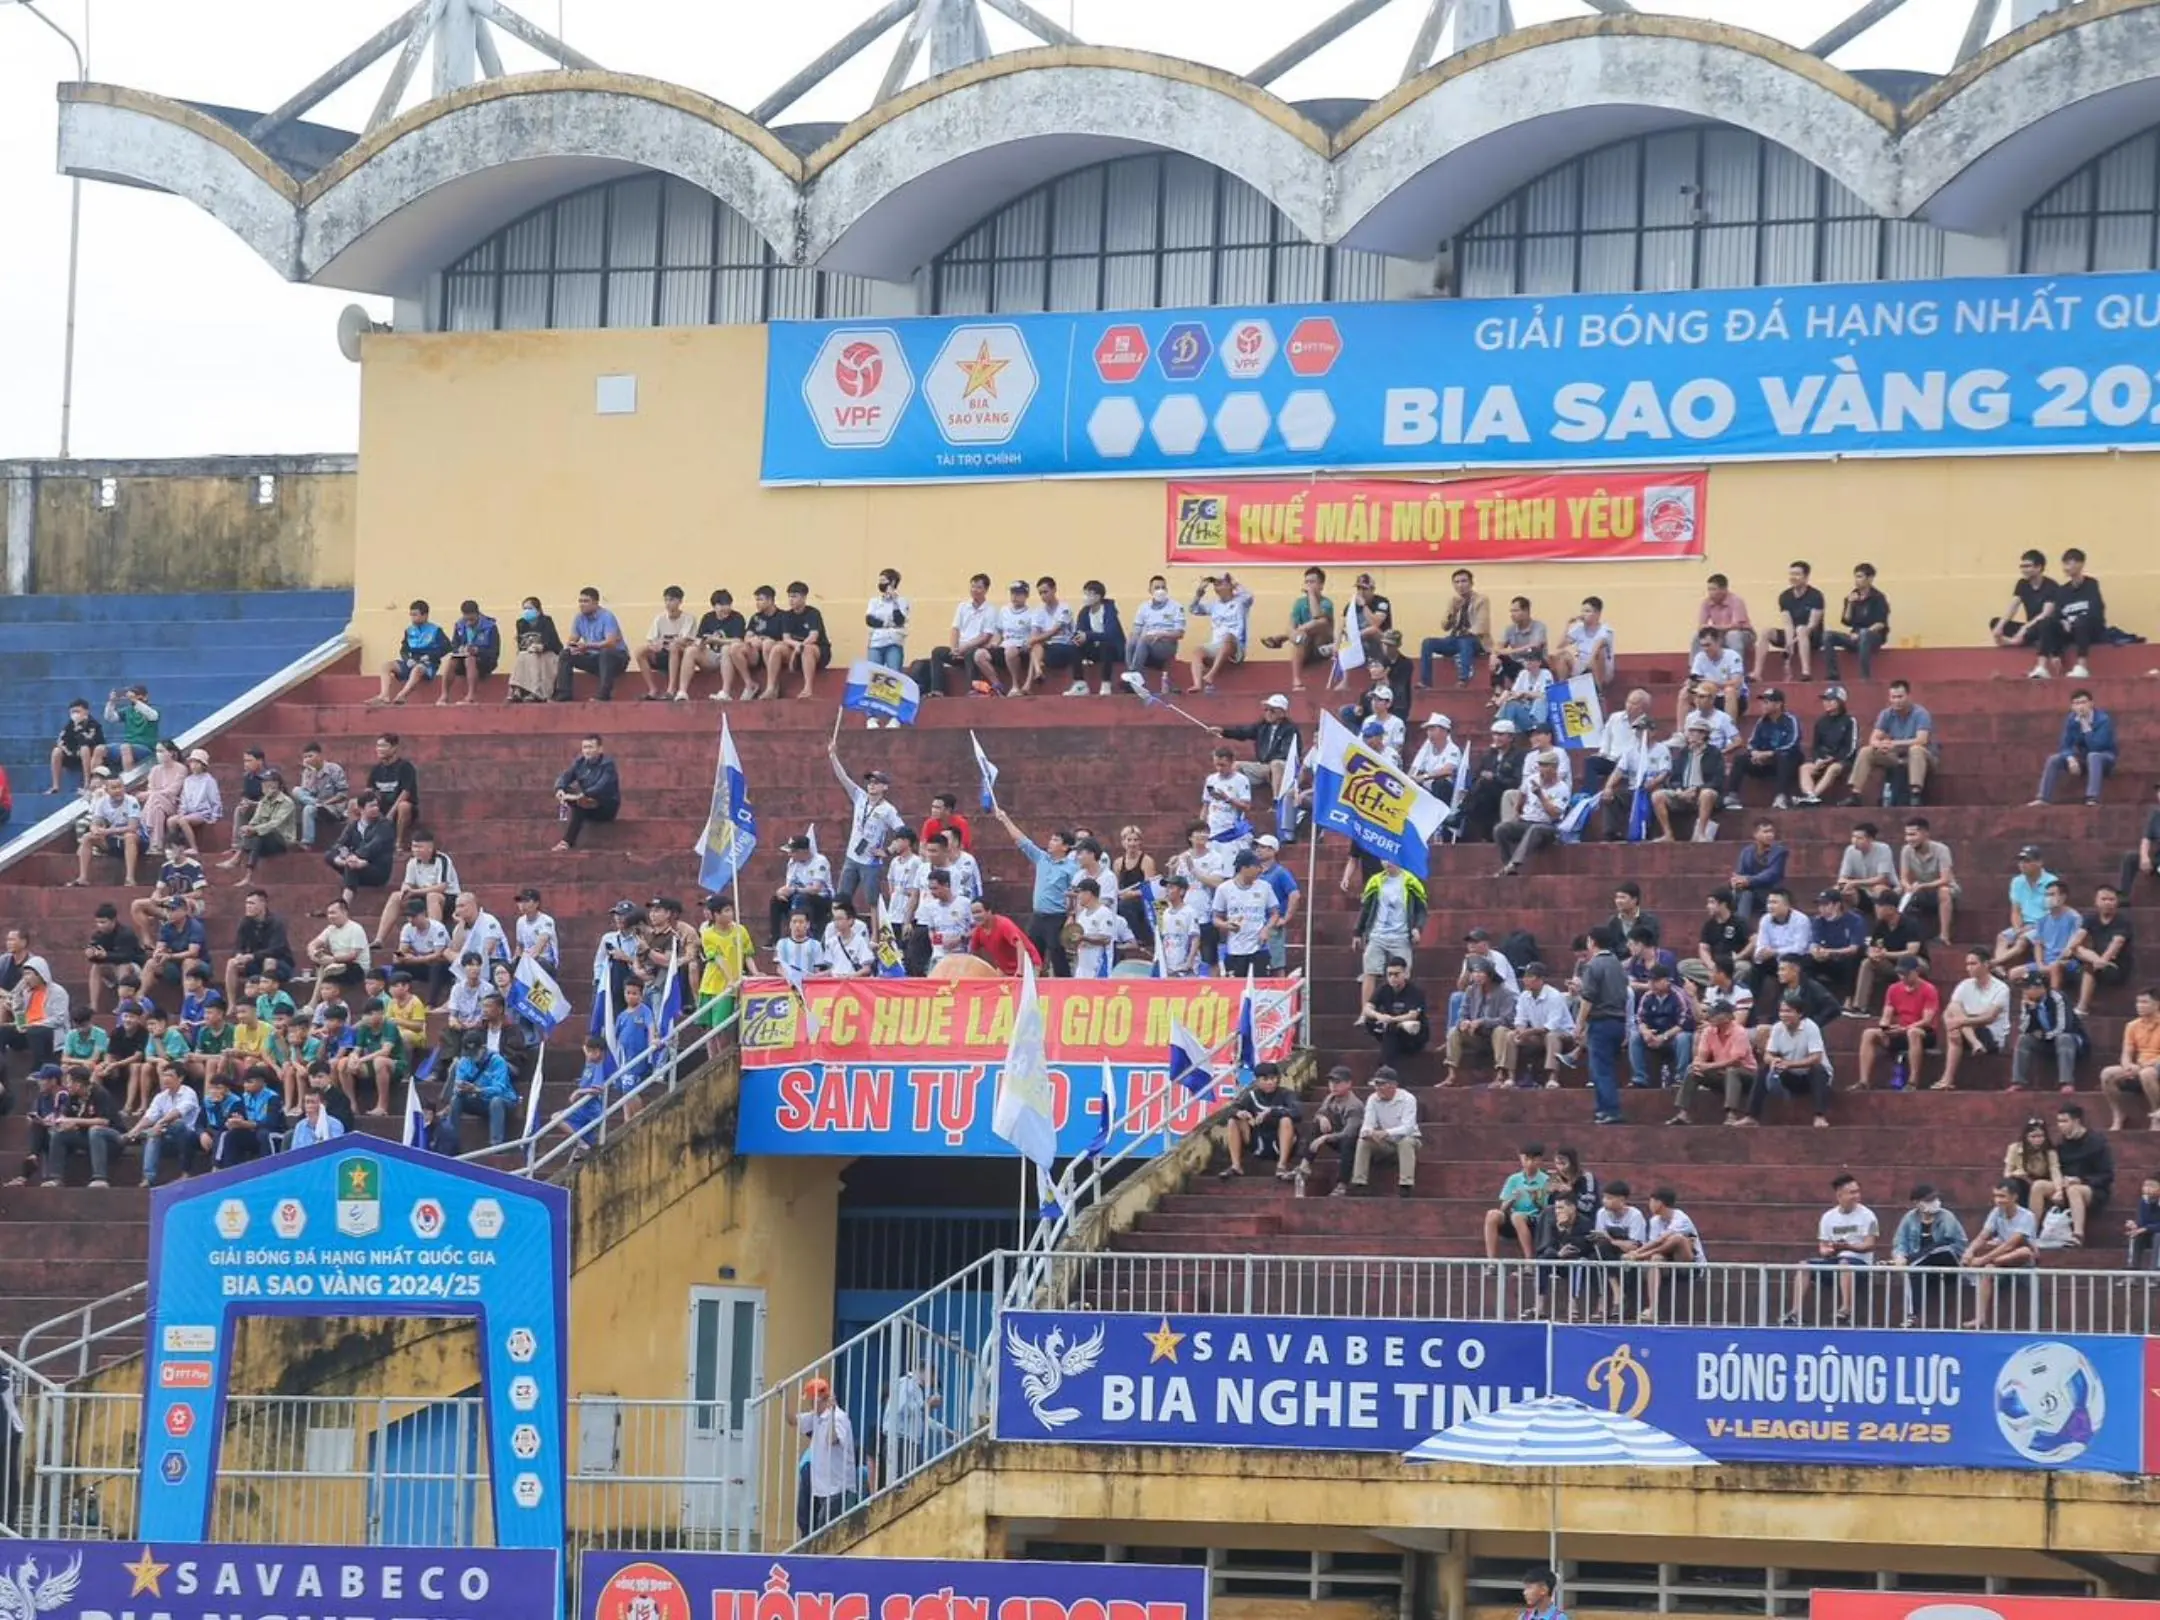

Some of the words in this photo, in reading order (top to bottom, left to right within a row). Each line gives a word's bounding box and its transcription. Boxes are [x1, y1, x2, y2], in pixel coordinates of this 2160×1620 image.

[1475, 304, 1564, 350] GIẢI
[1579, 305, 1708, 347] BÓNG
[1725, 298, 1789, 342] ĐÁ
[1806, 301, 1939, 346] HẠNG
[1955, 282, 2081, 333] NHẤT
[834, 406, 881, 427] VPF
[949, 413, 972, 425] SAO
[969, 399, 989, 409] BIA
[1383, 385, 1531, 446] BIA
[1549, 378, 1736, 442] SAO
[1759, 354, 2012, 436] VÀNG
[2032, 364, 2160, 428] 20
[936, 453, 954, 466] TÀI
[984, 451, 1021, 465] CHÍNH
[1239, 490, 1310, 544] HUẾ
[1315, 494, 1381, 543] MÃI
[1391, 492, 1464, 551] MỘT
[1475, 490, 1556, 541] TÌNH
[1567, 488, 1635, 540] YÊU
[744, 996, 789, 1020] FC
[811, 996, 859, 1046] FC
[870, 980, 959, 1046] HUẾ
[1061, 985, 1133, 1046] GIÓ
[1144, 984, 1231, 1047] MỚI
[908, 1065, 986, 1145] TỰ
[208, 1246, 241, 1265] GIẢI
[245, 1246, 291, 1265] BÓNG
[295, 1246, 317, 1265] ĐÁ
[321, 1250, 366, 1268] HẠNG
[370, 1244, 414, 1265] NHẤT
[418, 1244, 464, 1265] QUỐC
[467, 1250, 496, 1265] GIA
[222, 1275, 262, 1296] BIA
[266, 1274, 314, 1296] SAO
[318, 1269, 383, 1296] VÀNG
[387, 1272, 481, 1298] 2024/25
[1193, 1331, 1486, 1370] SAVABECO
[1697, 1343, 1786, 1403] BÓNG
[1795, 1345, 1886, 1412] ĐỘNG
[1896, 1351, 1960, 1415] LỰC
[1102, 1375, 1196, 1425] BIA
[1216, 1377, 1379, 1429] NGHE
[1706, 1417, 1850, 1443] V-LEAGUE
[1857, 1420, 1951, 1444] 24/25
[176, 1561, 490, 1601] SAVABECO
